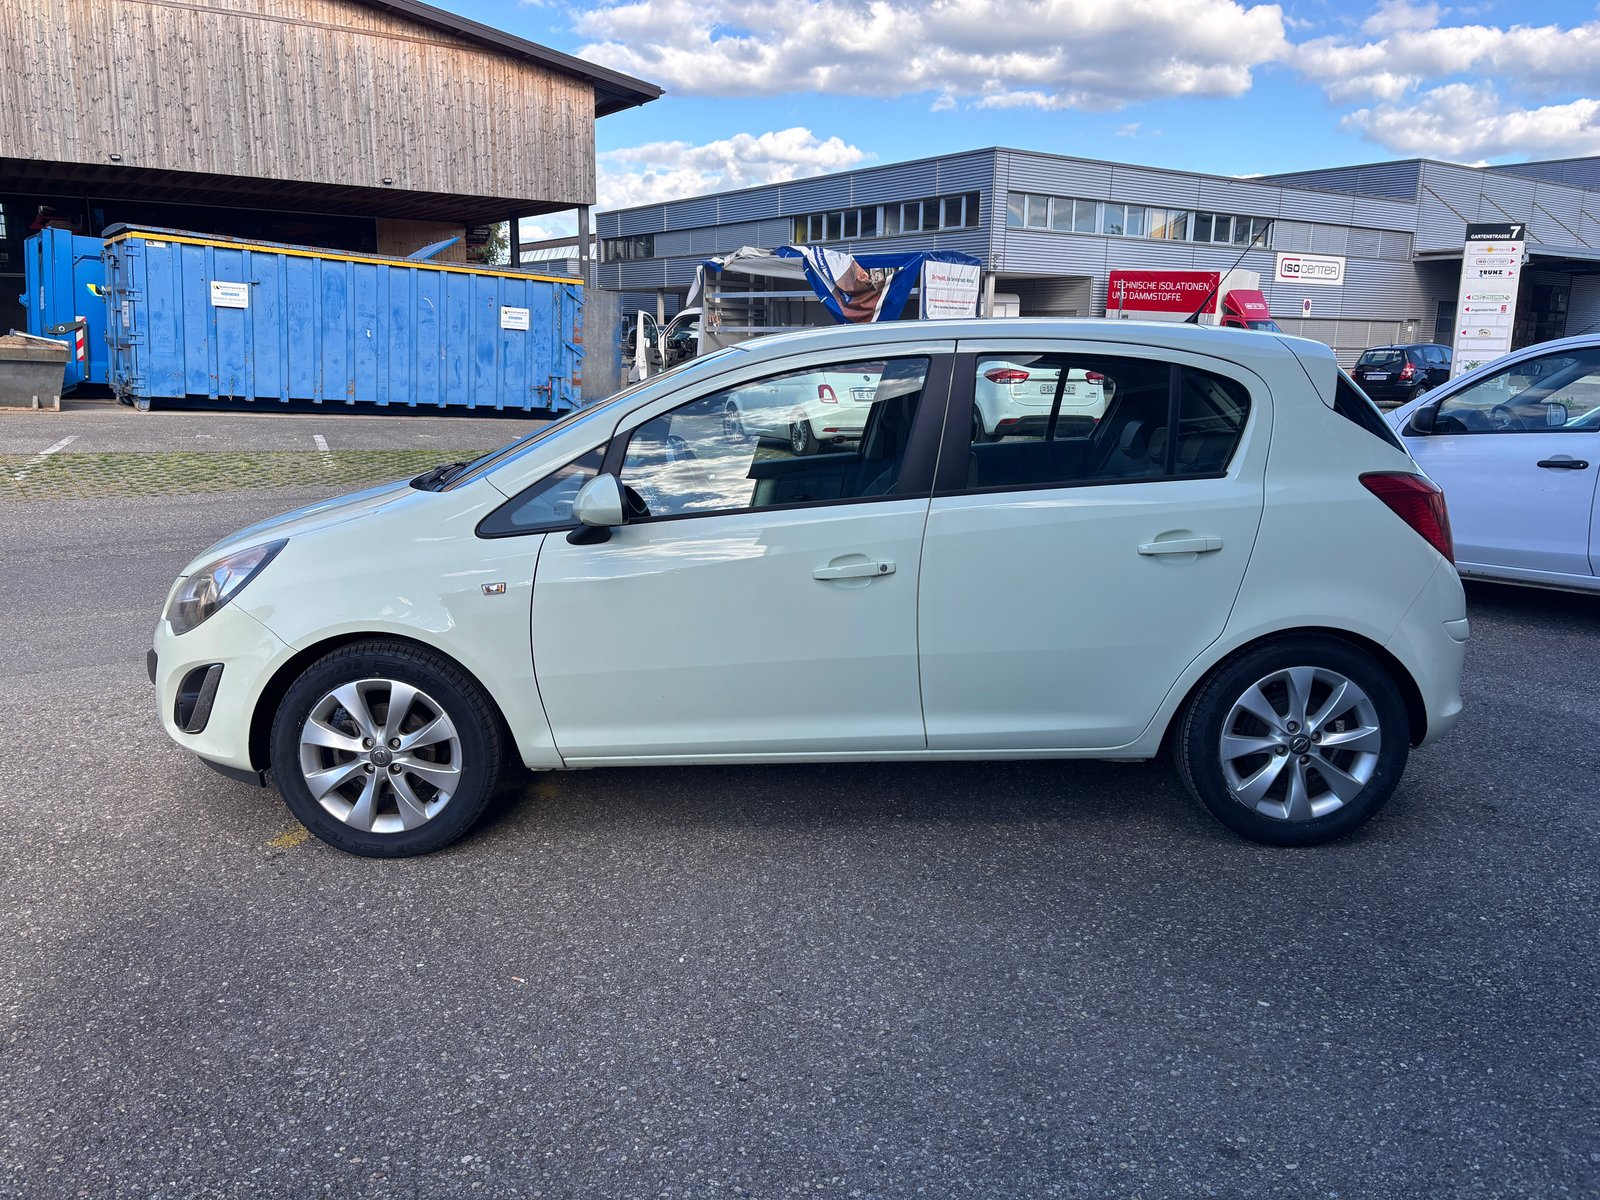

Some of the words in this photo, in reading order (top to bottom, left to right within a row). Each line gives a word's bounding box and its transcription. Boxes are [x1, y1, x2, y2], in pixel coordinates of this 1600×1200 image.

[1510, 225, 1521, 239] 7
[1112, 280, 1157, 290] TECHNISCHE
[1158, 281, 1210, 291] ISOLATIONEN
[1129, 289, 1183, 302] DÄMMSTOFFE.
